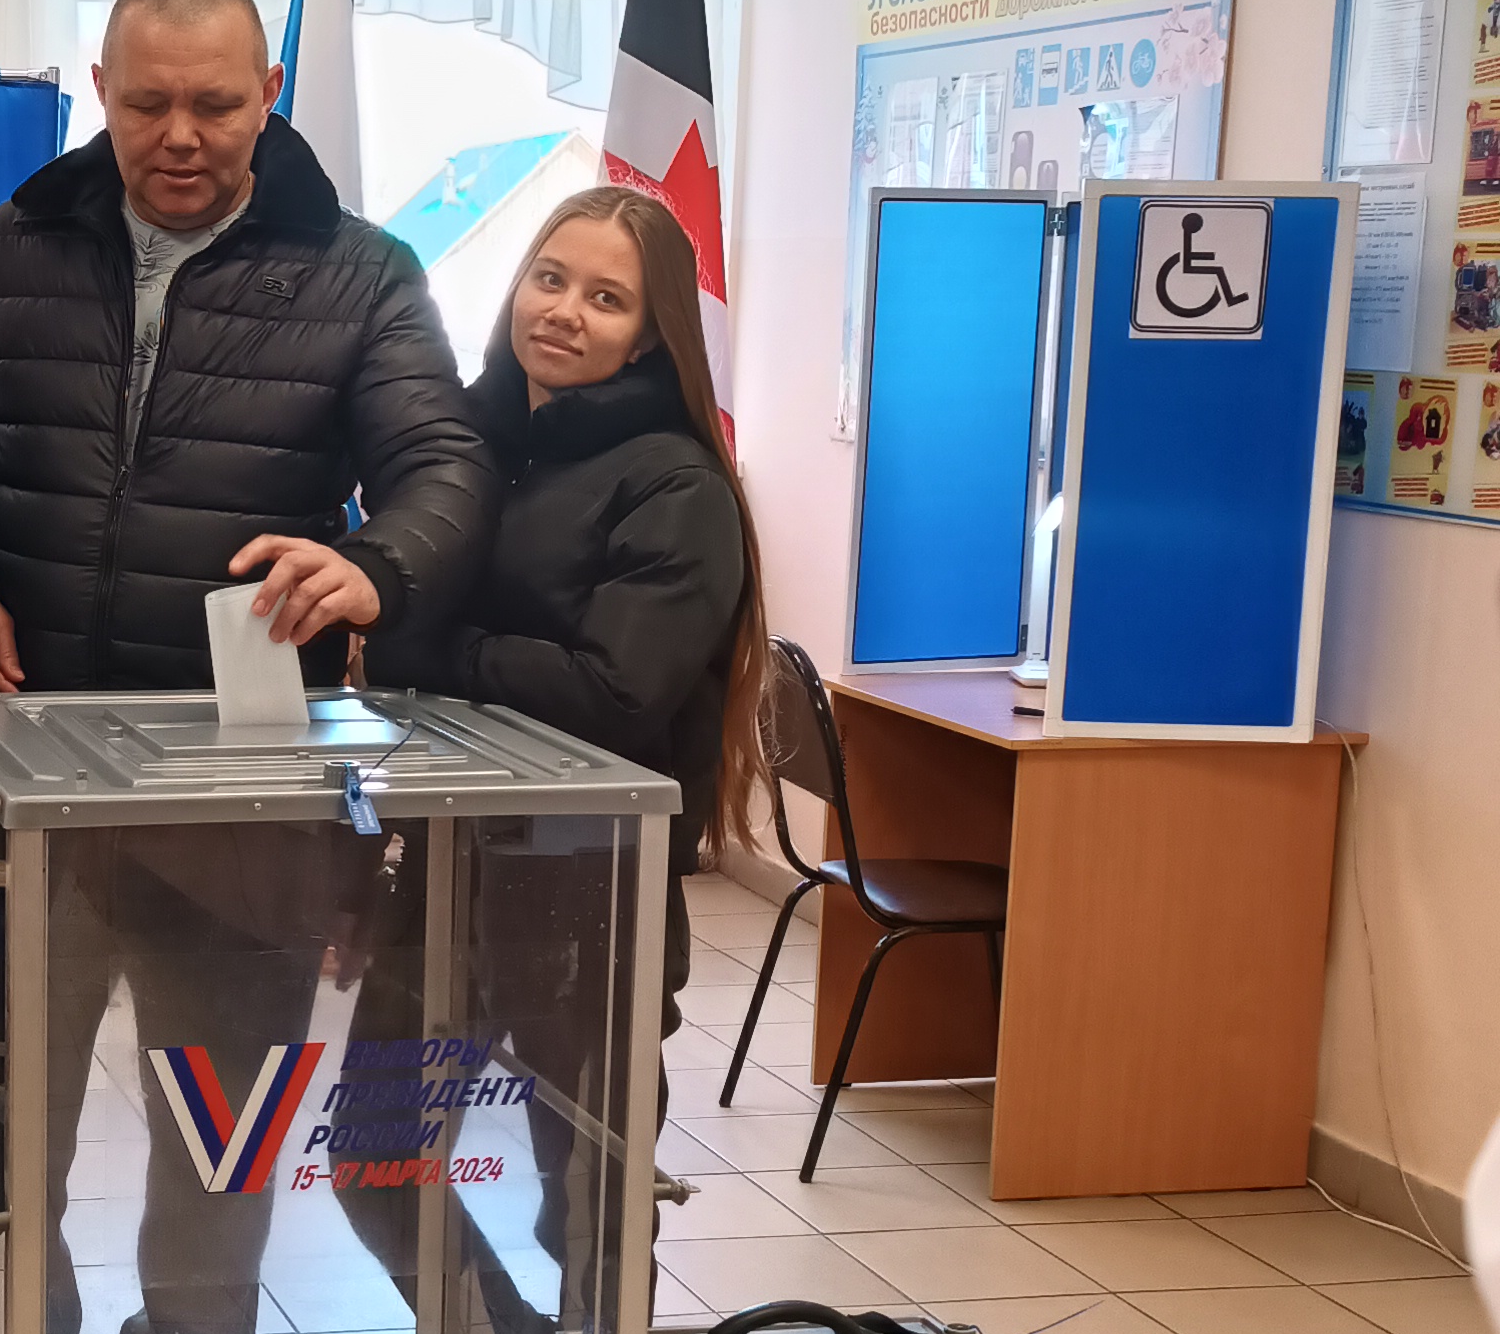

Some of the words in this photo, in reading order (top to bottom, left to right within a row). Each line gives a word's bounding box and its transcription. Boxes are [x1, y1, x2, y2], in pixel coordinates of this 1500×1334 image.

[340, 1037, 494, 1070] ВЫБОРЫ
[322, 1076, 537, 1113] ПРЕЗИДЕНТА
[303, 1120, 445, 1154] РОССИИ
[358, 1159, 442, 1188] МАРТА
[446, 1156, 504, 1186] 2024
